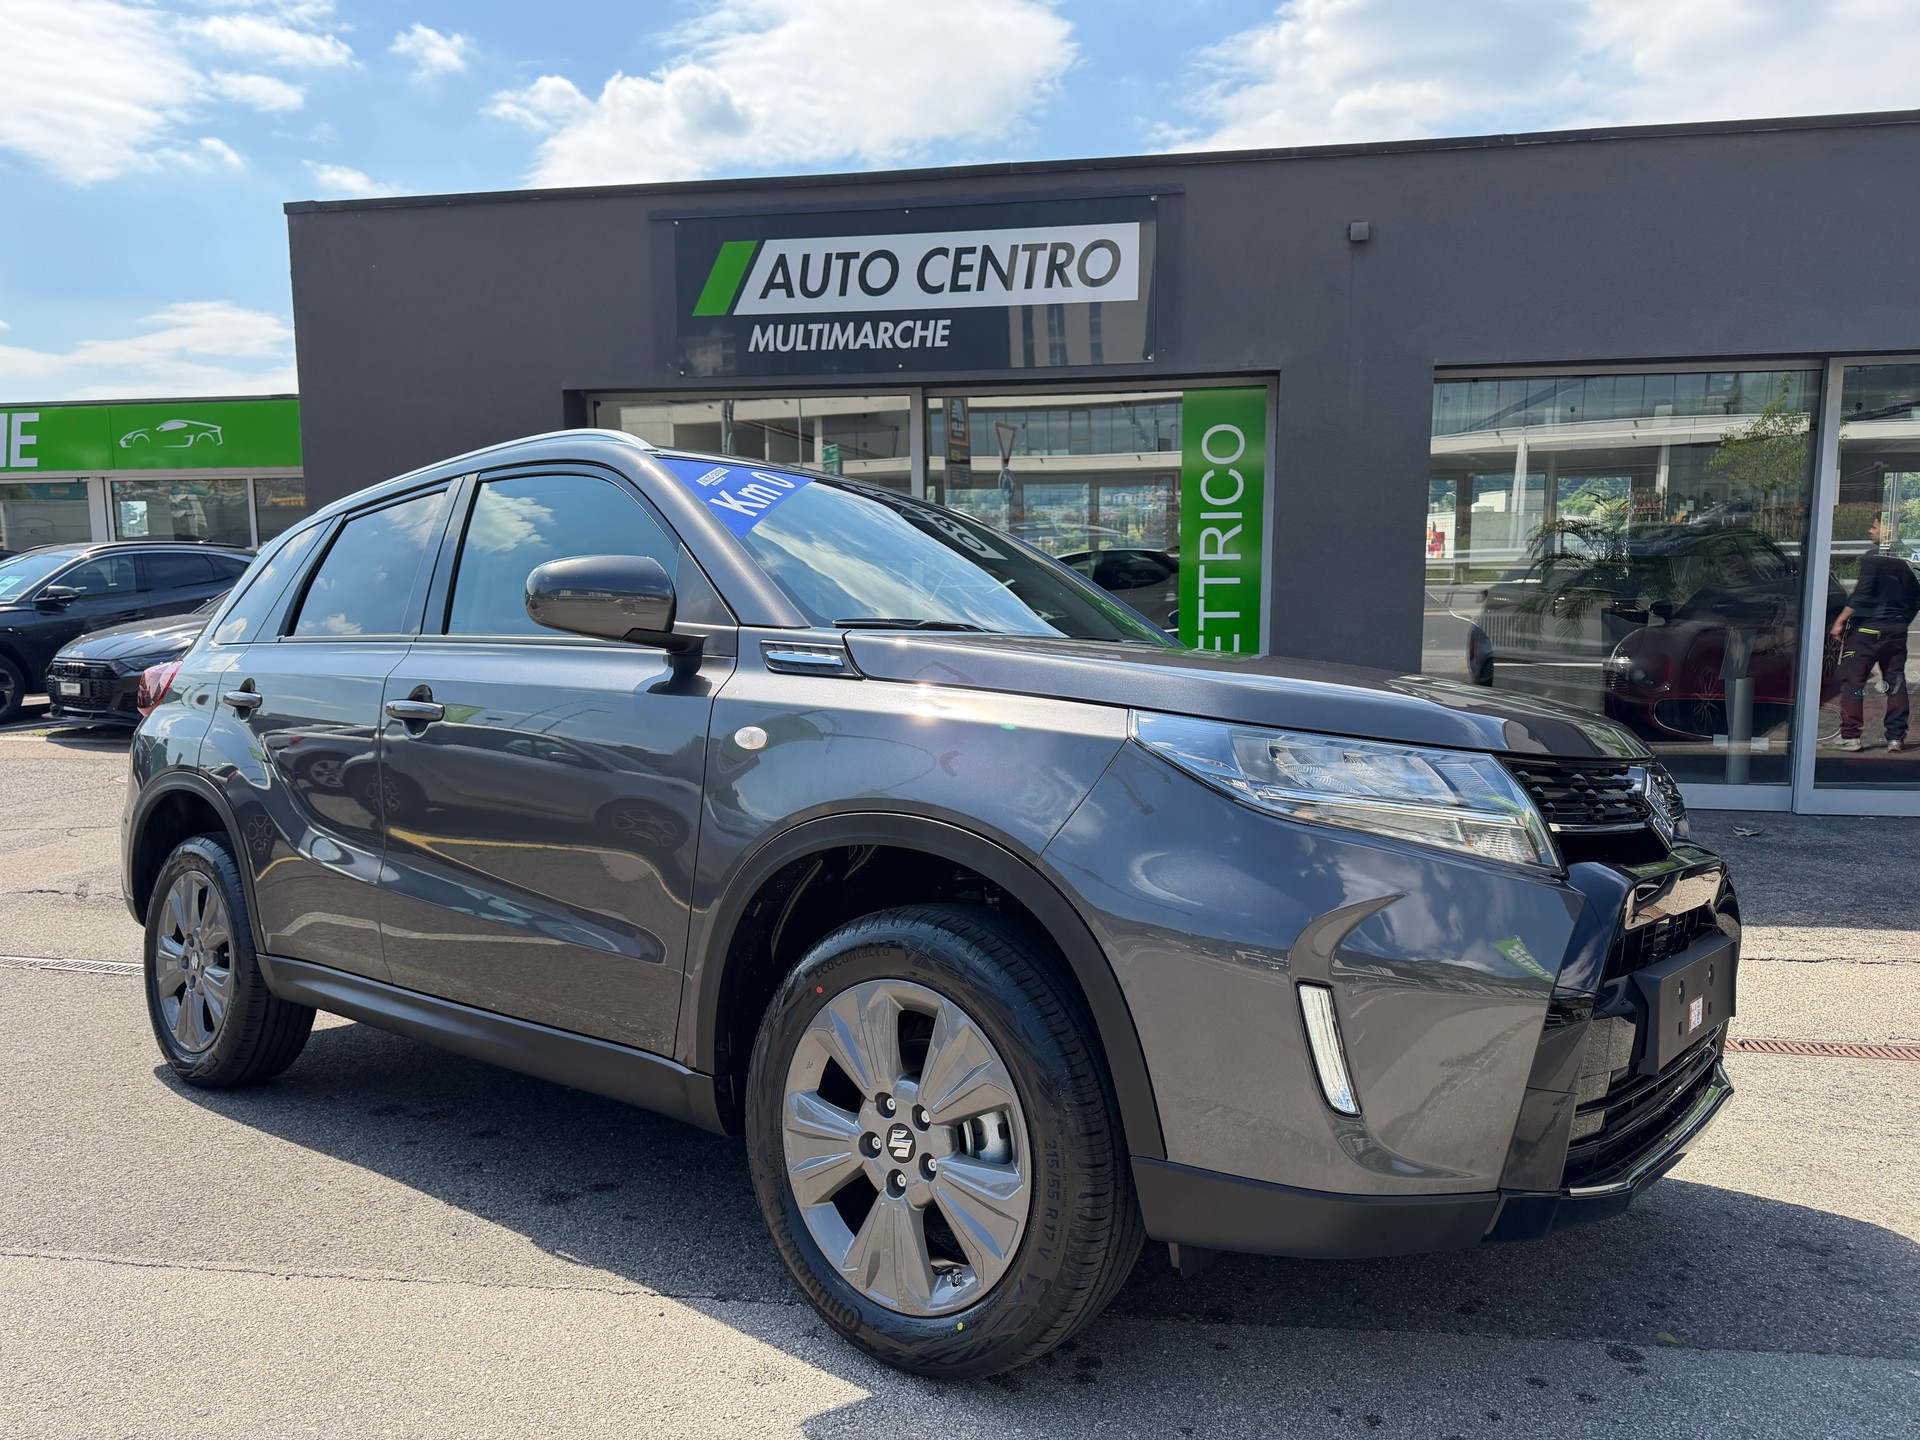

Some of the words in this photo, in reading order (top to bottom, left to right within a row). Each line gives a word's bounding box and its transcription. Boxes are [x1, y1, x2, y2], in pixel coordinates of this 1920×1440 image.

[758, 249, 900, 300] AUTO
[916, 238, 1122, 295] CENTRO
[747, 319, 952, 352] MULTIMARCHE
[0, 412, 40, 467] E
[709, 483, 784, 517] Km
[750, 471, 796, 489] 0
[1044, 1139, 1061, 1201] 215/55
